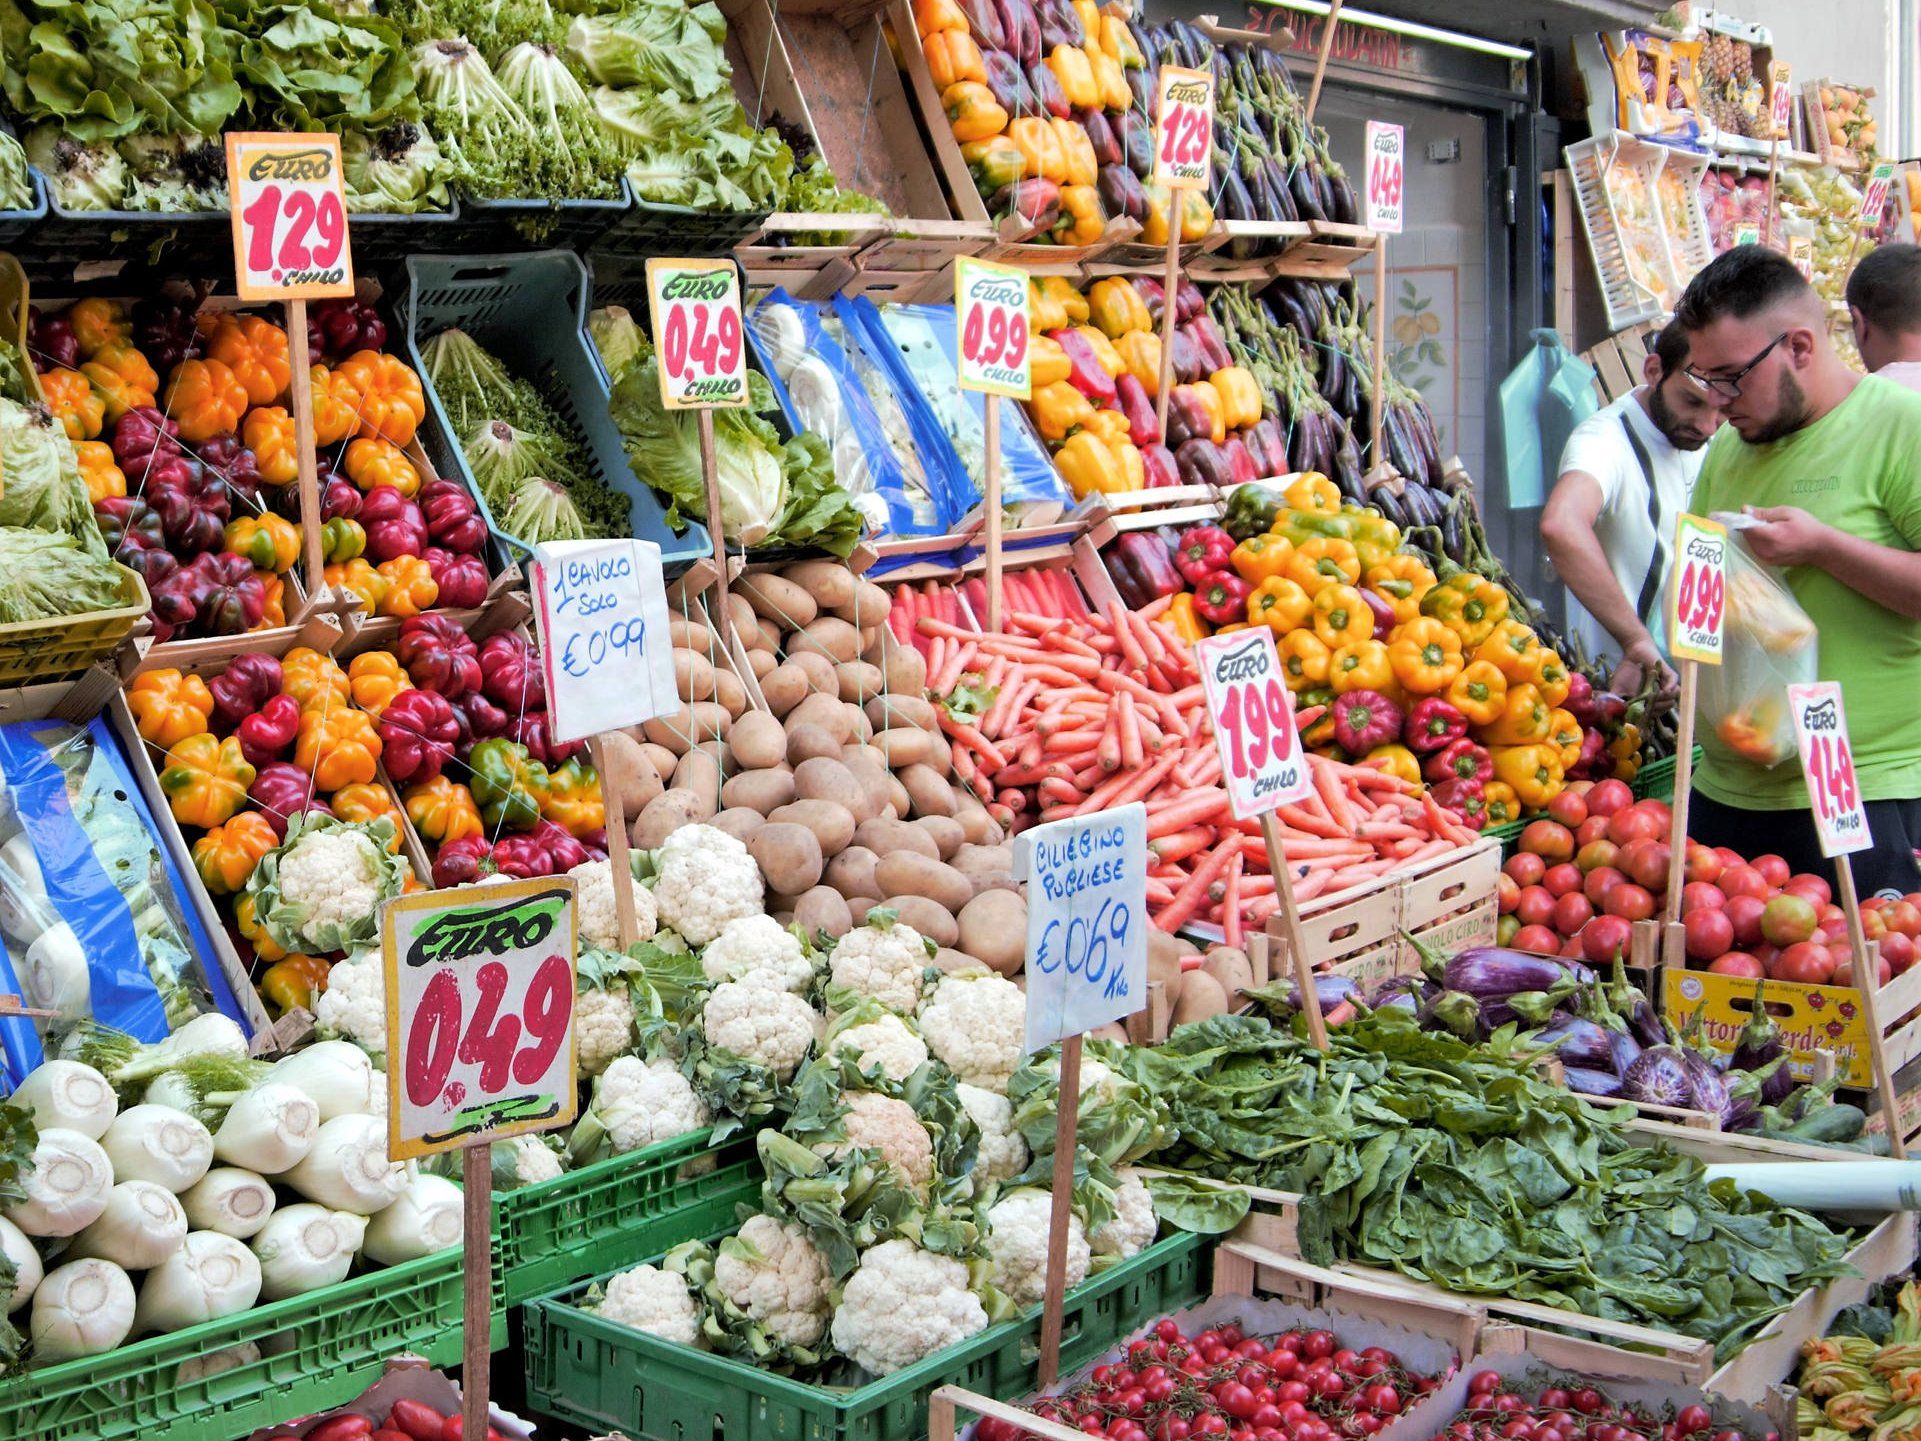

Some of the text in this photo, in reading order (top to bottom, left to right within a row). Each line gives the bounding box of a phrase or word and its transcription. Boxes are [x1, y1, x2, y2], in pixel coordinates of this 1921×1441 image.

[1165, 80, 1210, 105] EURO
[249, 149, 333, 181] EURO
[282, 268, 344, 287] CHILO
[662, 269, 735, 301] EURO
[970, 279, 1025, 307] EURO
[684, 378, 742, 396] CHILO
[1687, 537, 1724, 565] EURO
[568, 556, 630, 588] CAVOLO
[1689, 631, 1719, 647] CHILO
[1216, 638, 1270, 684] EURO
[1804, 698, 1837, 730] EURO
[1253, 766, 1298, 798] CHILO
[406, 888, 572, 967] EURO
